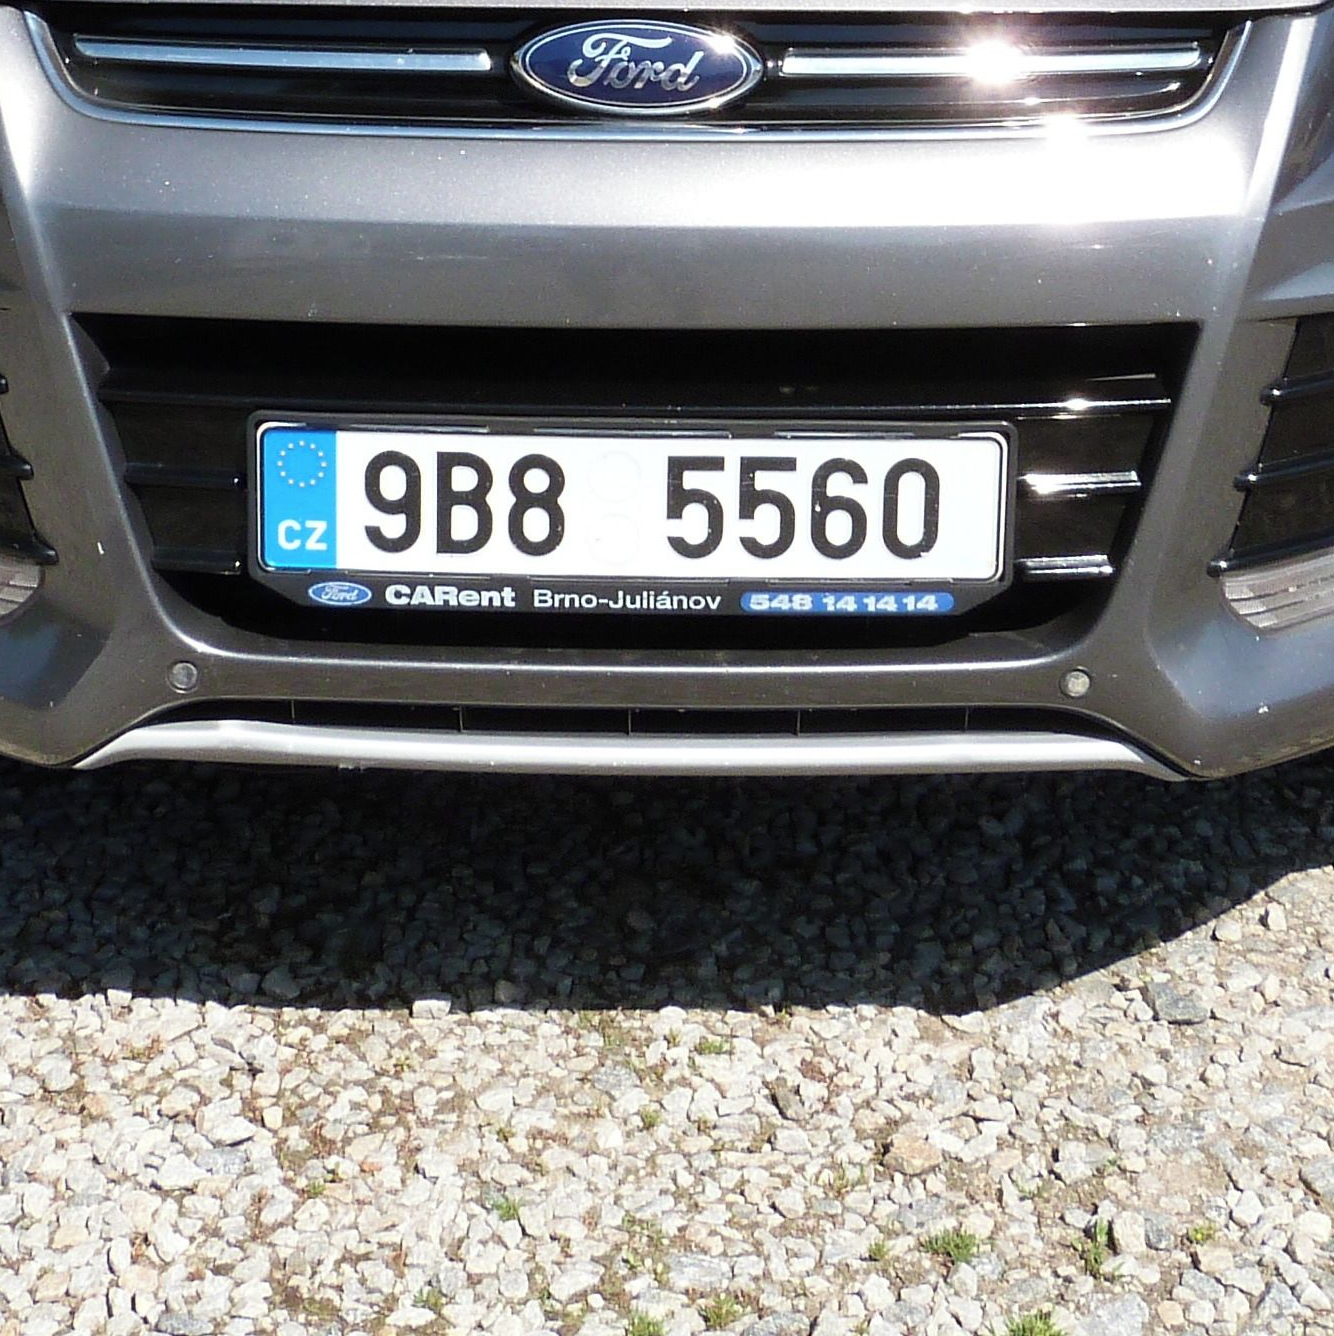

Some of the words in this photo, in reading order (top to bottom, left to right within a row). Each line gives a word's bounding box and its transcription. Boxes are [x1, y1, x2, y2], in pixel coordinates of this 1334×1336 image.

[567, 33, 704, 91] Ford
[364, 450, 566, 557] 9B8
[666, 456, 940, 560] 5560
[277, 519, 329, 551] CZ
[320, 582, 359, 601] Ford
[384, 584, 516, 607] CARent
[533, 589, 722, 610] Brno-Juliánov
[749, 594, 812, 610] 548
